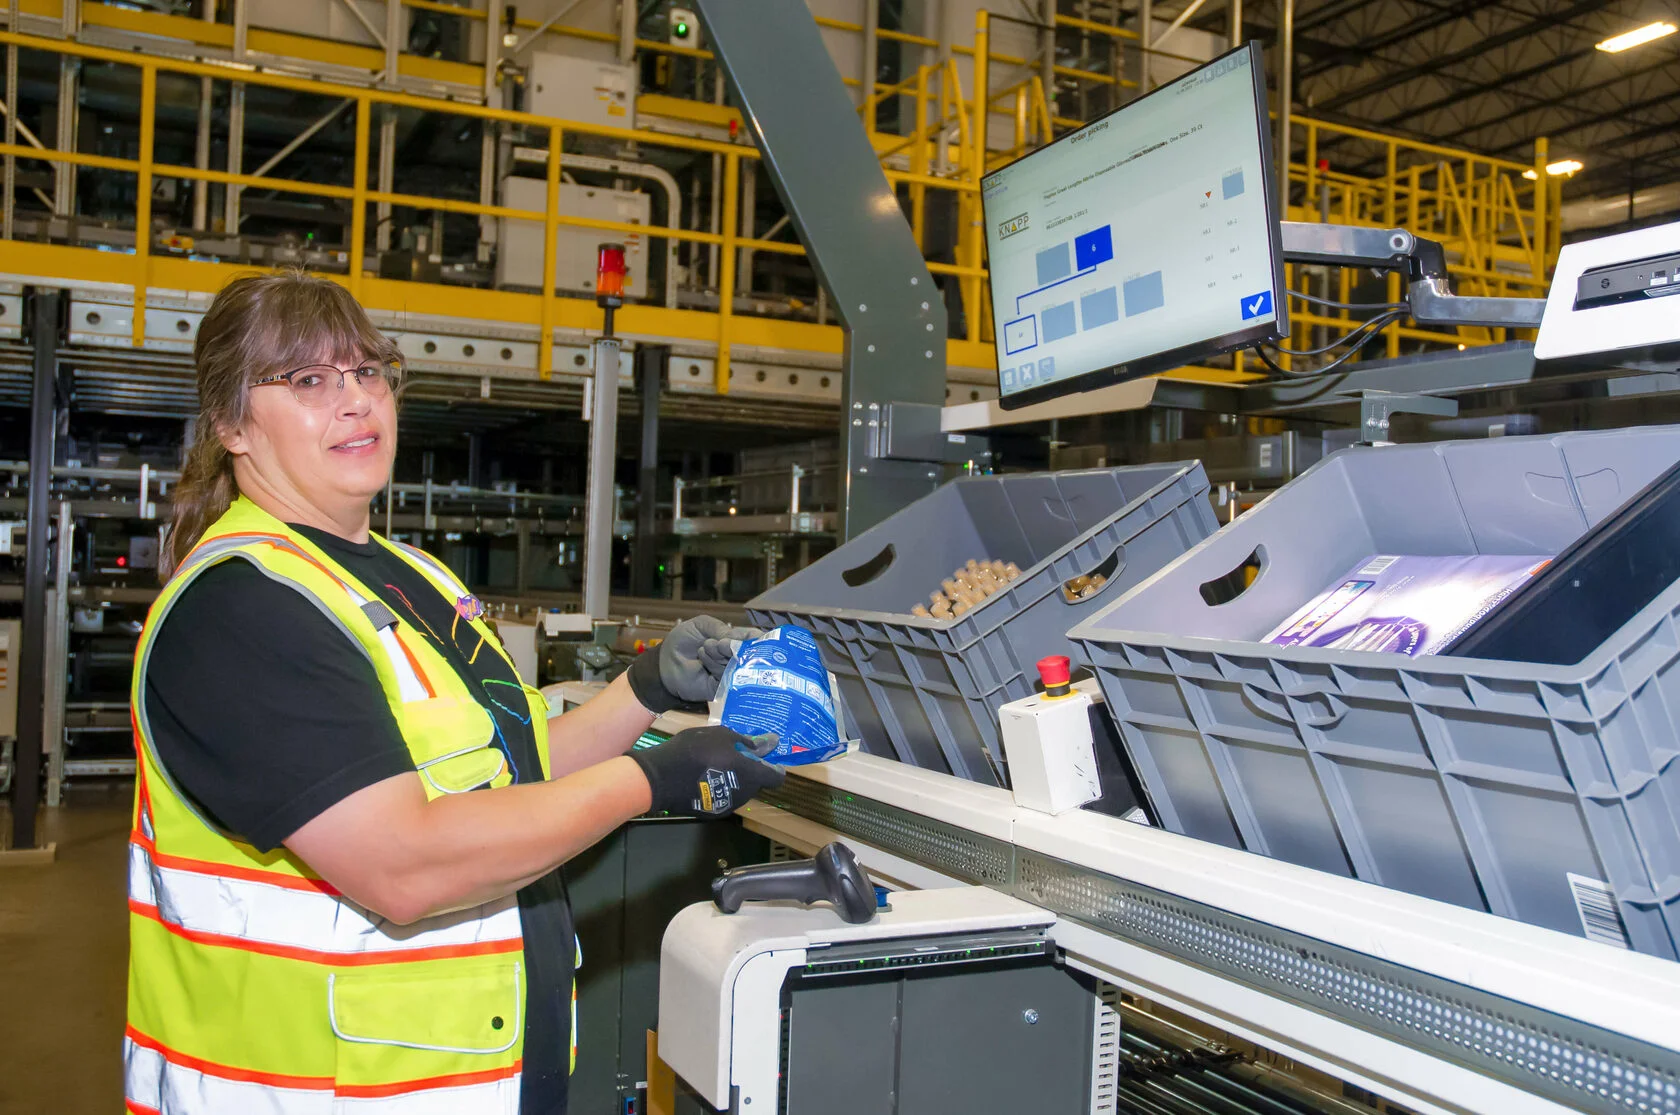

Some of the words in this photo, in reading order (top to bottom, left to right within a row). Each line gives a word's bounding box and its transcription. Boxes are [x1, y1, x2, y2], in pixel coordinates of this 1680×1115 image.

[1070, 132, 1087, 144] Order
[1088, 121, 1109, 136] picking
[999, 214, 1030, 237] KNAPP
